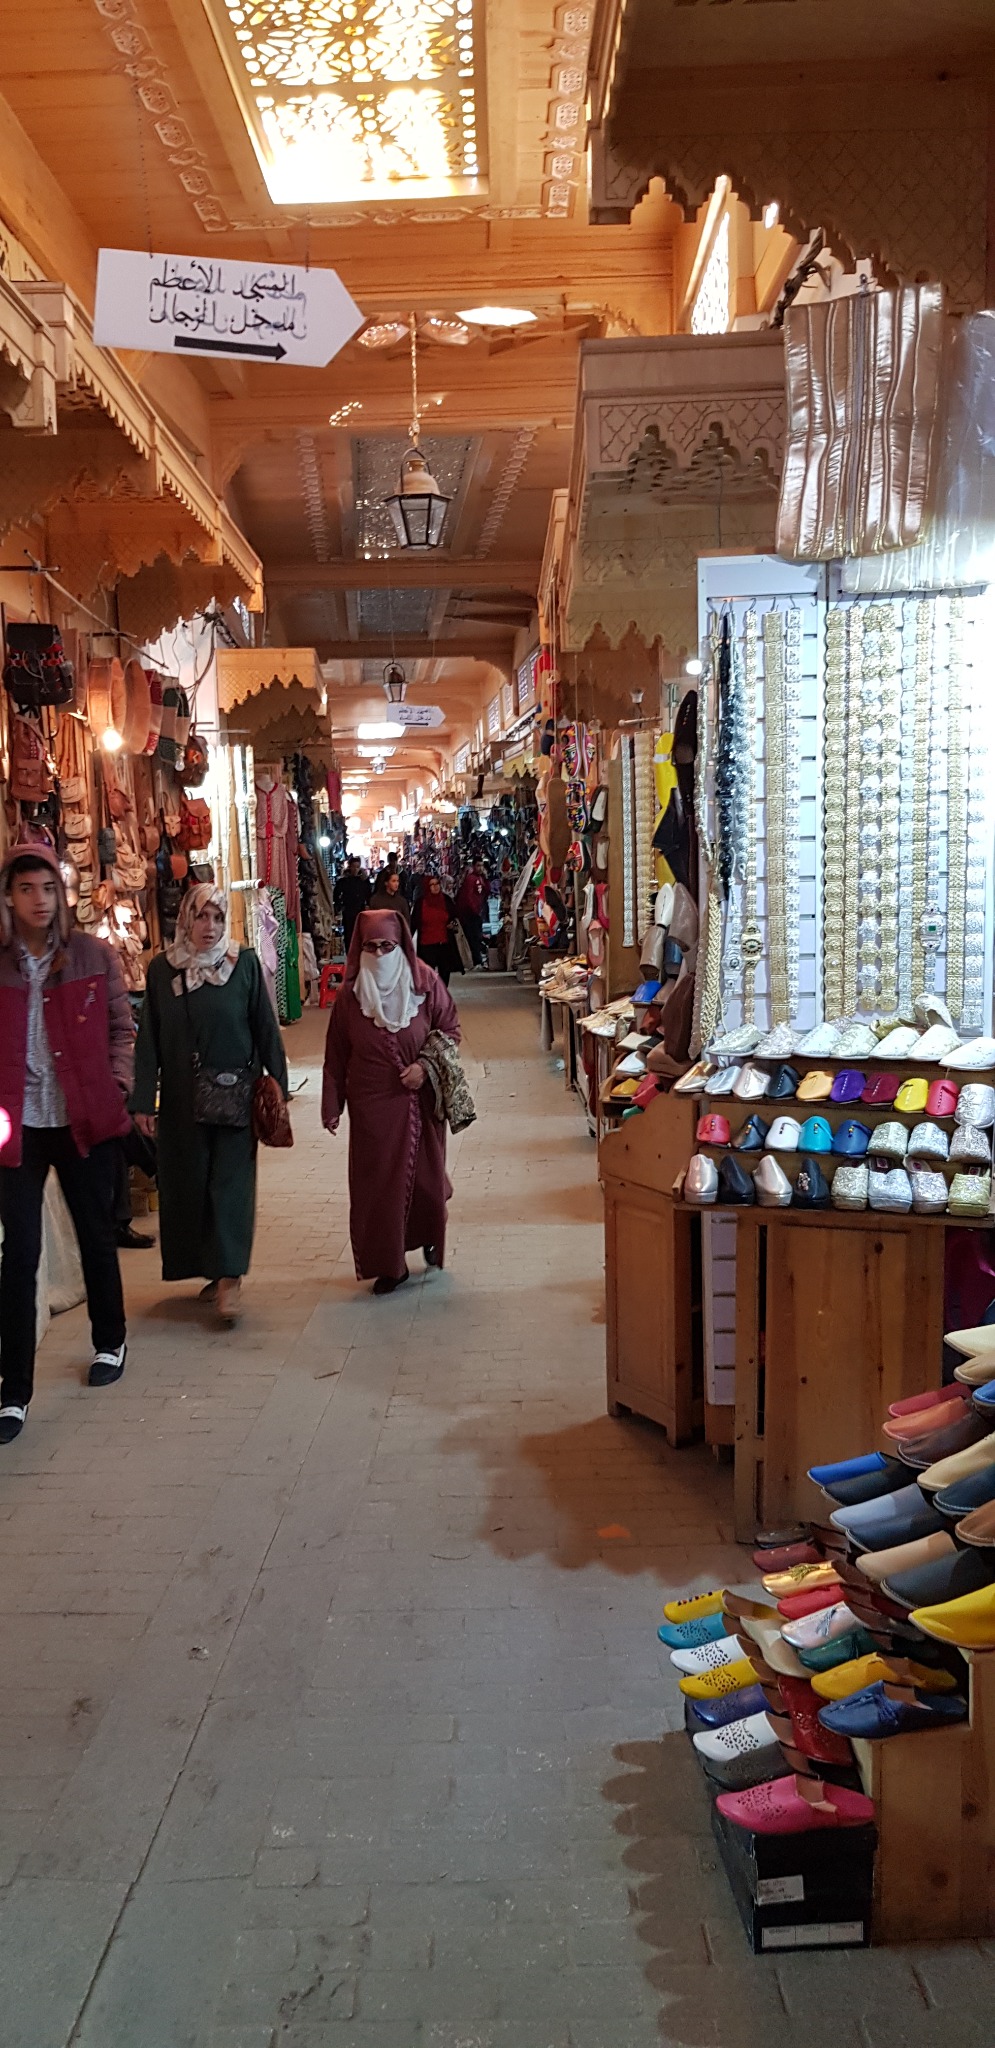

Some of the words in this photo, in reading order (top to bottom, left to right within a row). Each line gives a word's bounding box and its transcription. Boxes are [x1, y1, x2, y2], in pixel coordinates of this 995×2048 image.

[149, 259, 225, 303] الأعظم
[232, 271, 296, 302] المسجد
[229, 303, 296, 335] مدخل
